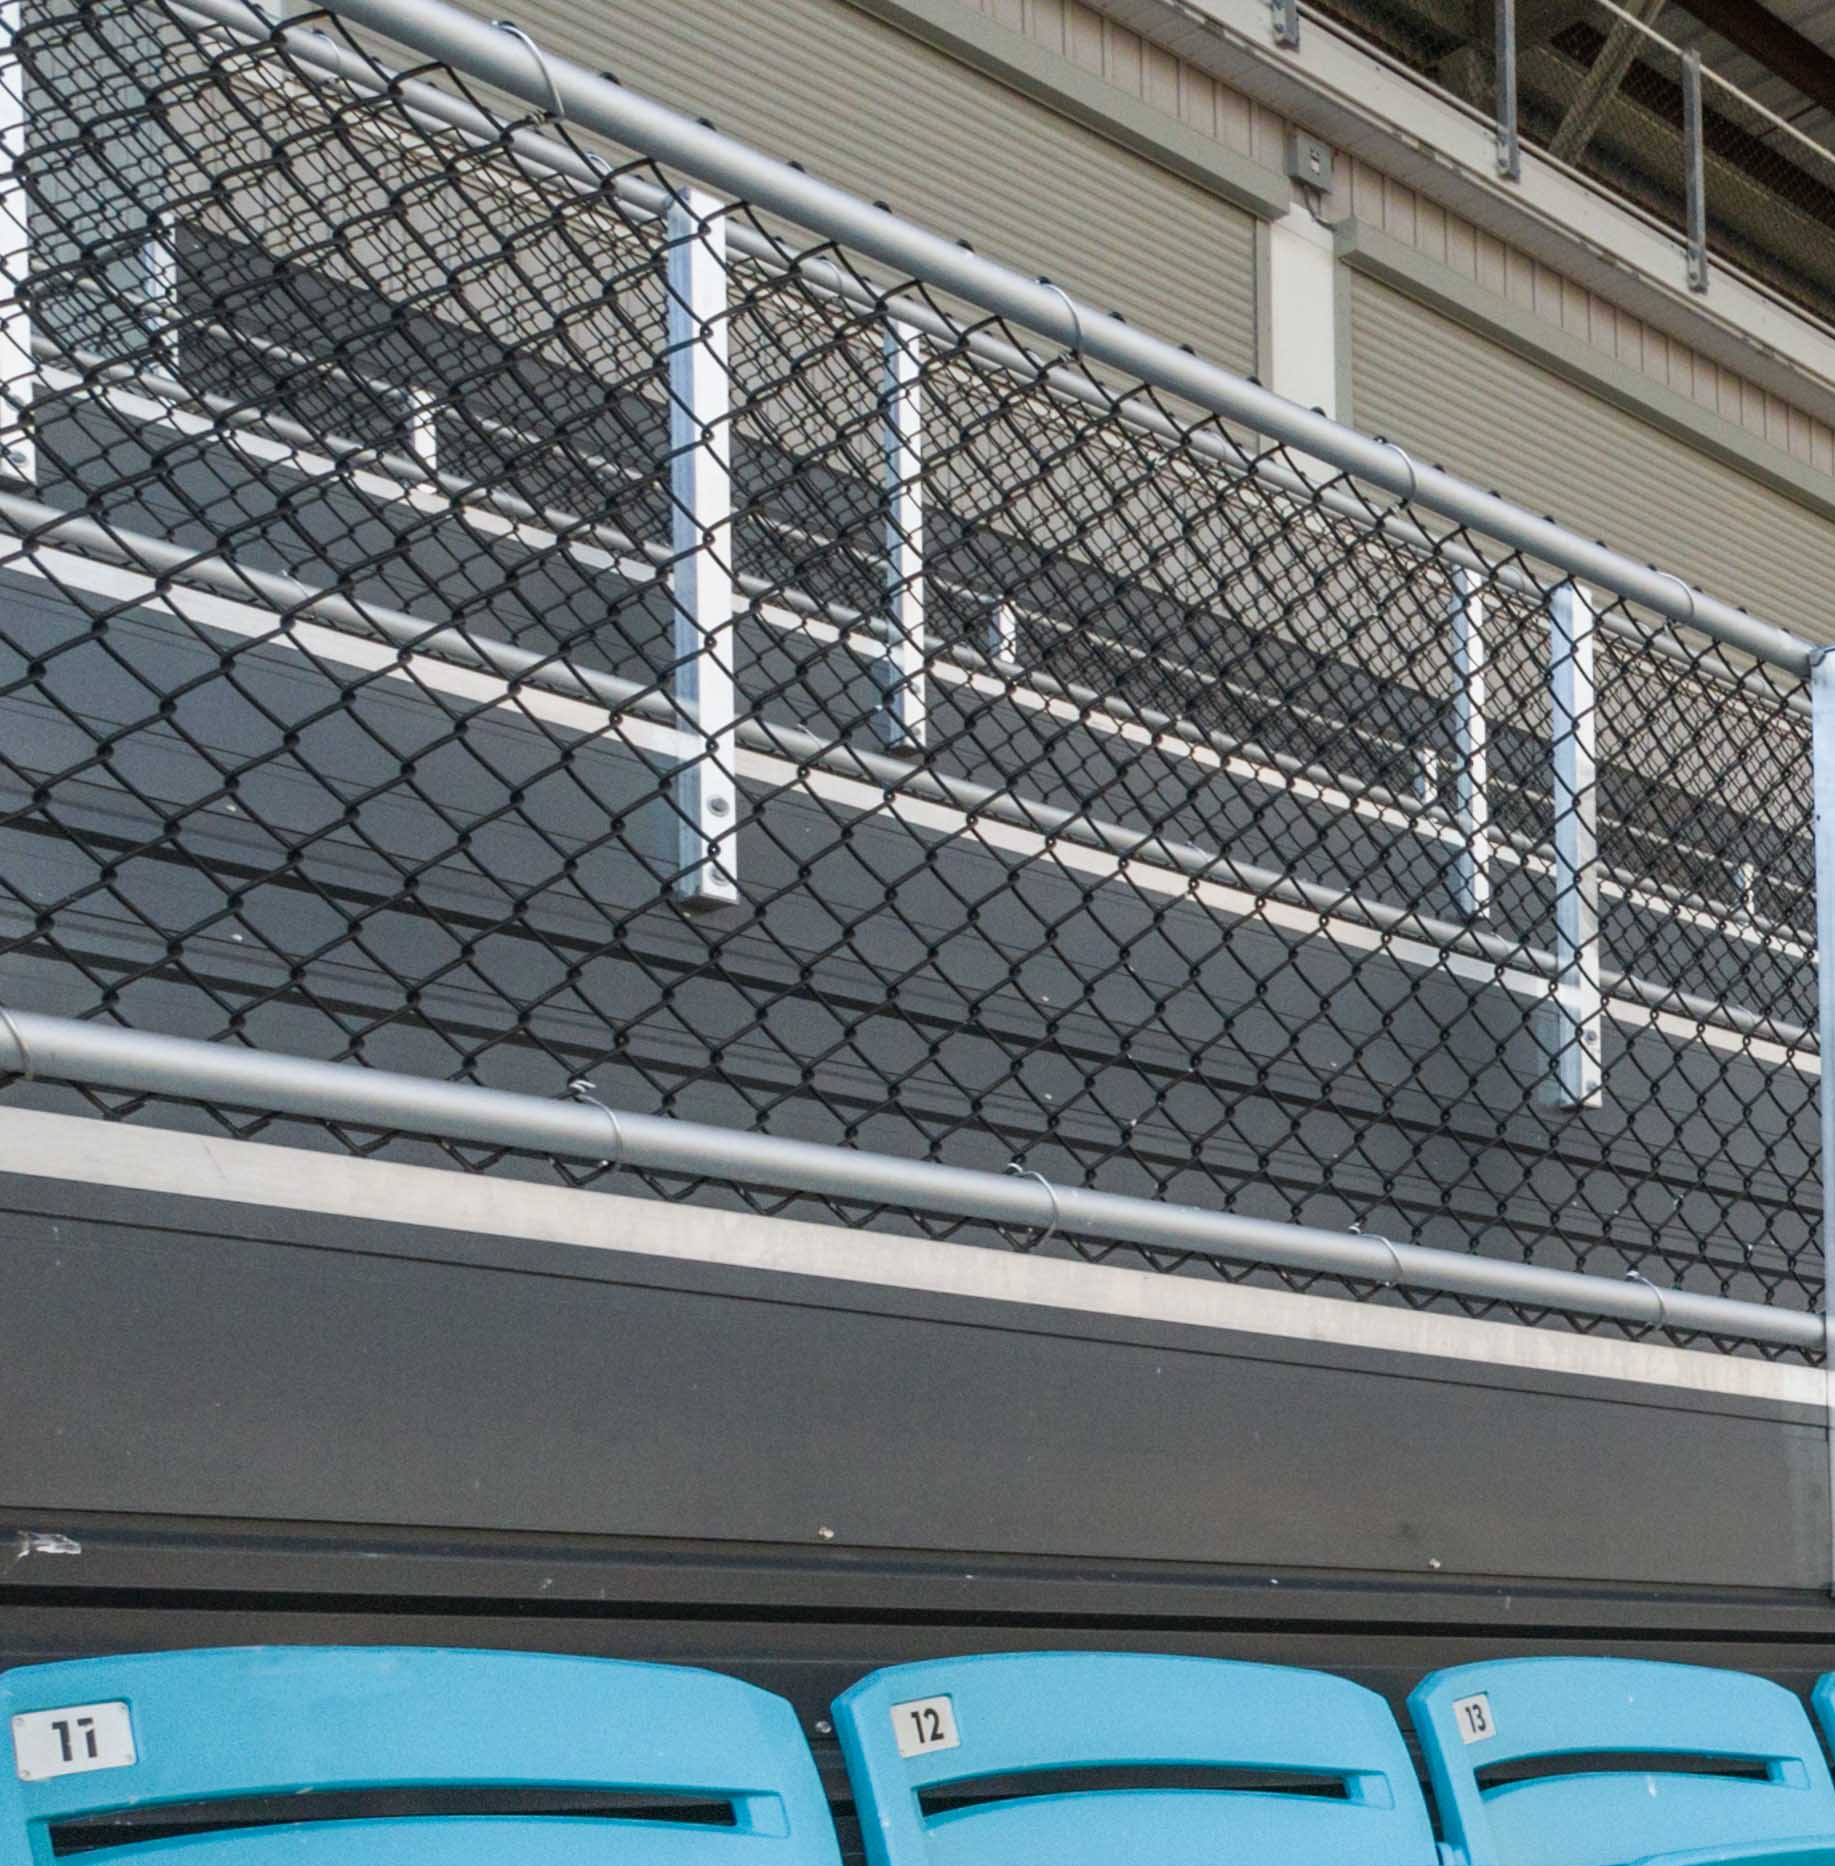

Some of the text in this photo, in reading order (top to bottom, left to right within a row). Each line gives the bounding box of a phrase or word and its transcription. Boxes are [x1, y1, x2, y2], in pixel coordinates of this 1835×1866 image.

[911, 1708, 944, 1743] 12
[1465, 1703, 1486, 1734] 13
[52, 1717, 97, 1761] 11
